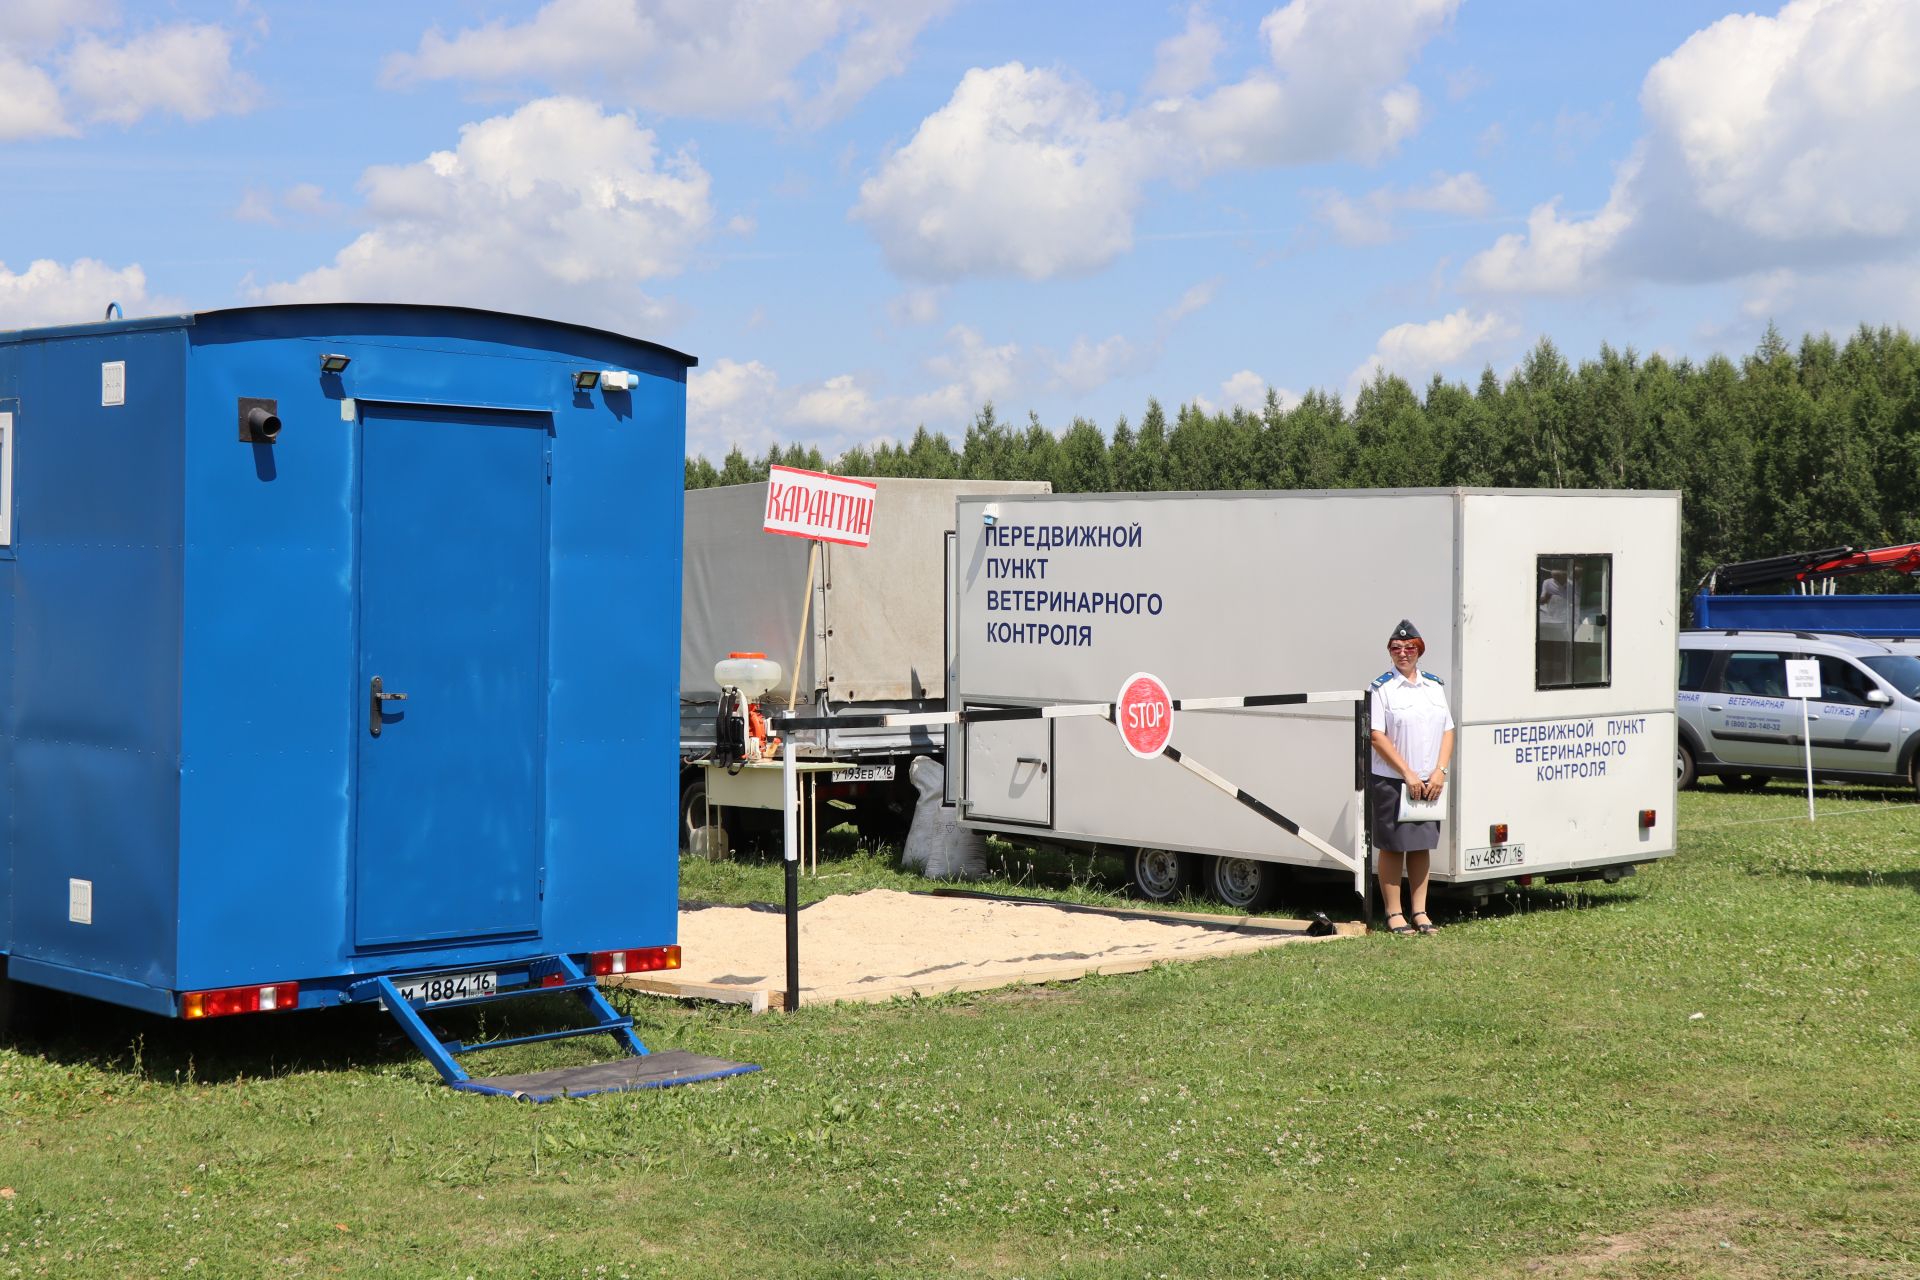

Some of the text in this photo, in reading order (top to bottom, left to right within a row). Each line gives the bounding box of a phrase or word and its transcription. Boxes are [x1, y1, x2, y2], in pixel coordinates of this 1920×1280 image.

[767, 482, 874, 535] КАРАНТИН
[985, 522, 1142, 551] ПЕРЕДВИЖНОЙ
[987, 558, 1049, 579] ПУНКТ
[987, 590, 1163, 615] ВЕТЕРИНАРНОГО
[987, 622, 1092, 647] КОНТРОЛЯ
[1128, 701, 1165, 729] STOP
[1728, 696, 1785, 709] ВЕТЕРИНАРНАЯ
[1824, 705, 1856, 717] СЛУЖБА
[1494, 718, 1646, 745] ПЕРЕДВИЖНОЙ ПУНКТ
[1515, 740, 1627, 764] ВЕТЕРИНАРНОГО
[876, 766, 892, 776] 716
[1537, 761, 1606, 782] КОНТРОЛЯ
[1483, 848, 1508, 865] 4837
[1513, 846, 1523, 858] 16
[420, 977, 467, 1002] 1884
[473, 973, 490, 991] 16
